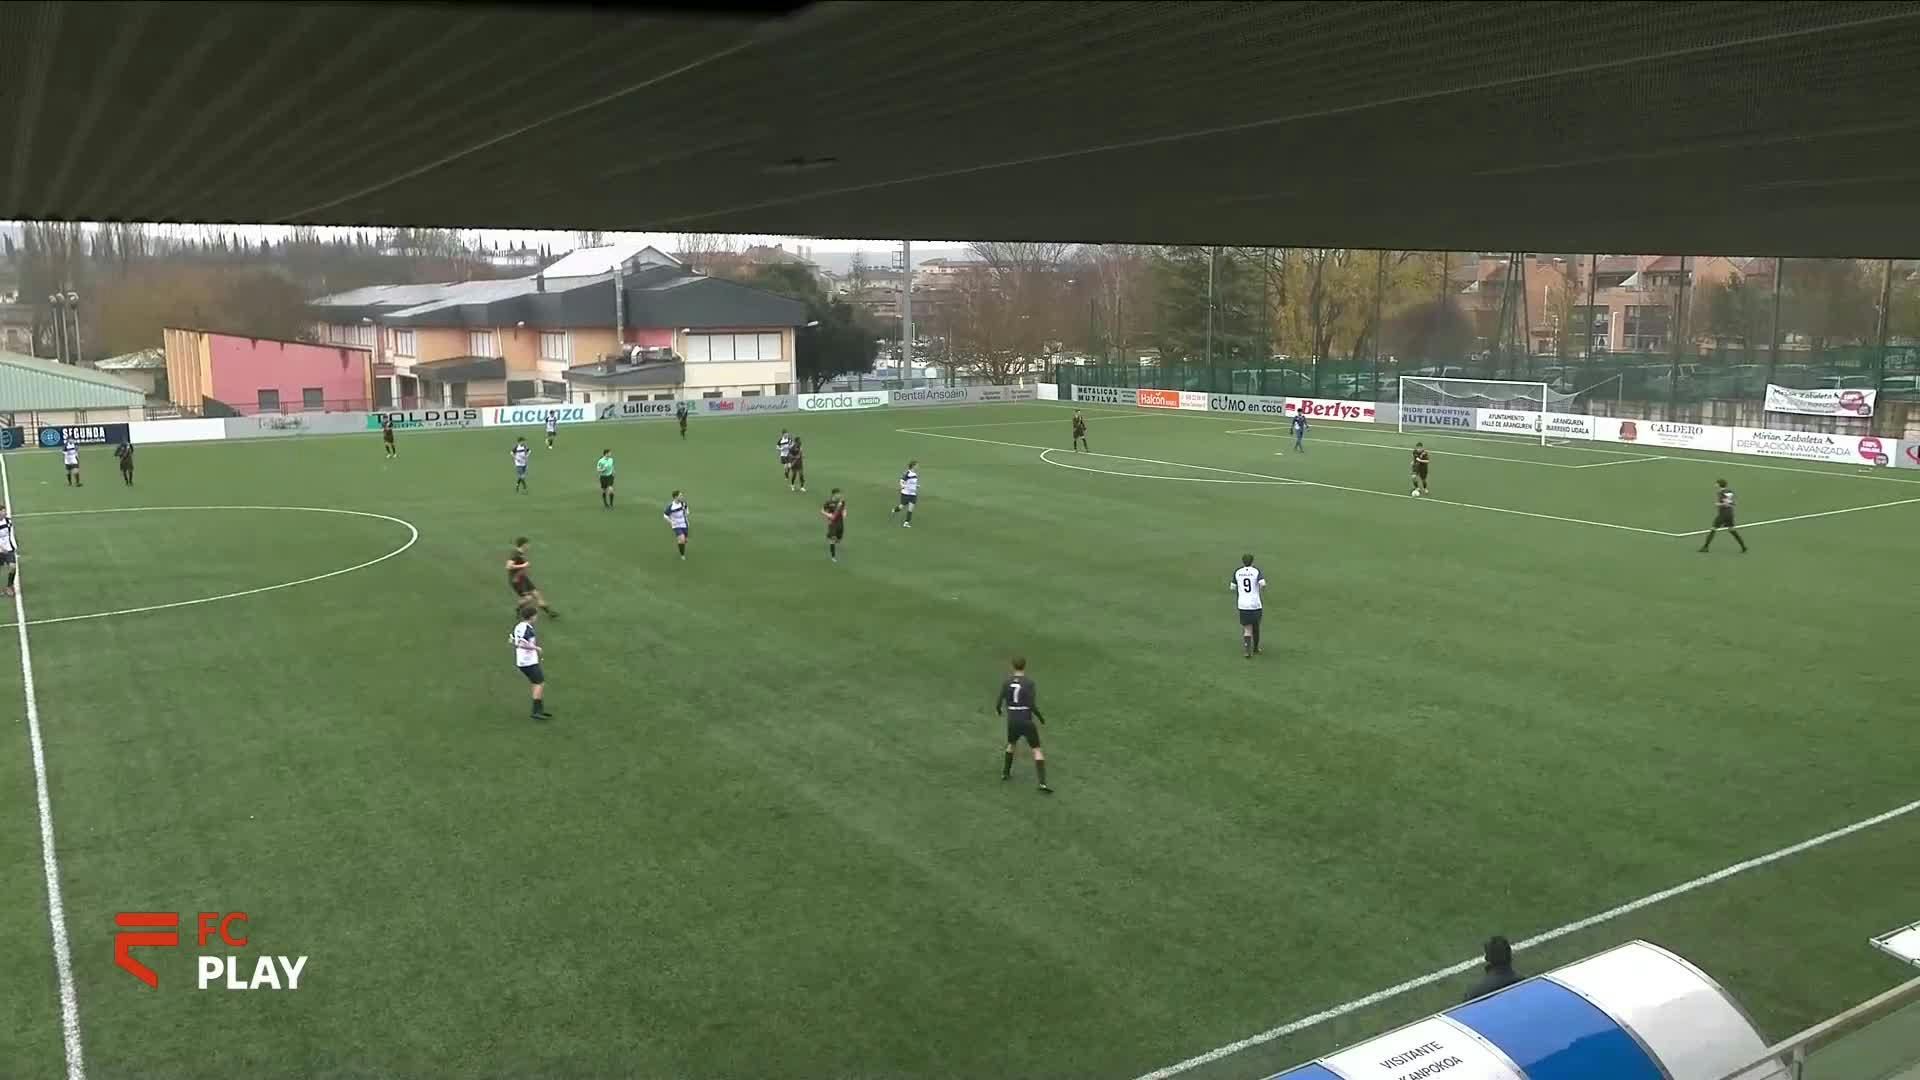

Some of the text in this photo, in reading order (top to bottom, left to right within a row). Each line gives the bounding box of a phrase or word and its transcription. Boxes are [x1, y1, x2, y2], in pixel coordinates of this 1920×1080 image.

[1078, 387, 1118, 396] METALICAS
[806, 394, 852, 409] denda
[1078, 395, 1118, 403] MUTILVA
[623, 402, 671, 414] talleres
[1248, 403, 1259, 412] en
[1261, 404, 1282, 413] casa
[1300, 399, 1360, 418] Berlys
[1426, 408, 1471, 417] DEPORTIVA
[371, 409, 477, 424] TOLDOS
[62, 426, 105, 440] SEGUNDA
[1650, 423, 1704, 435] CALDERO
[1784, 434, 1823, 444] Zabaleta
[1796, 445, 1851, 457] AVANZADA
[1243, 578, 1252, 593] 9
[1010, 683, 1021, 703] 7
[1380, 1041, 1444, 1070] VISITANTE
